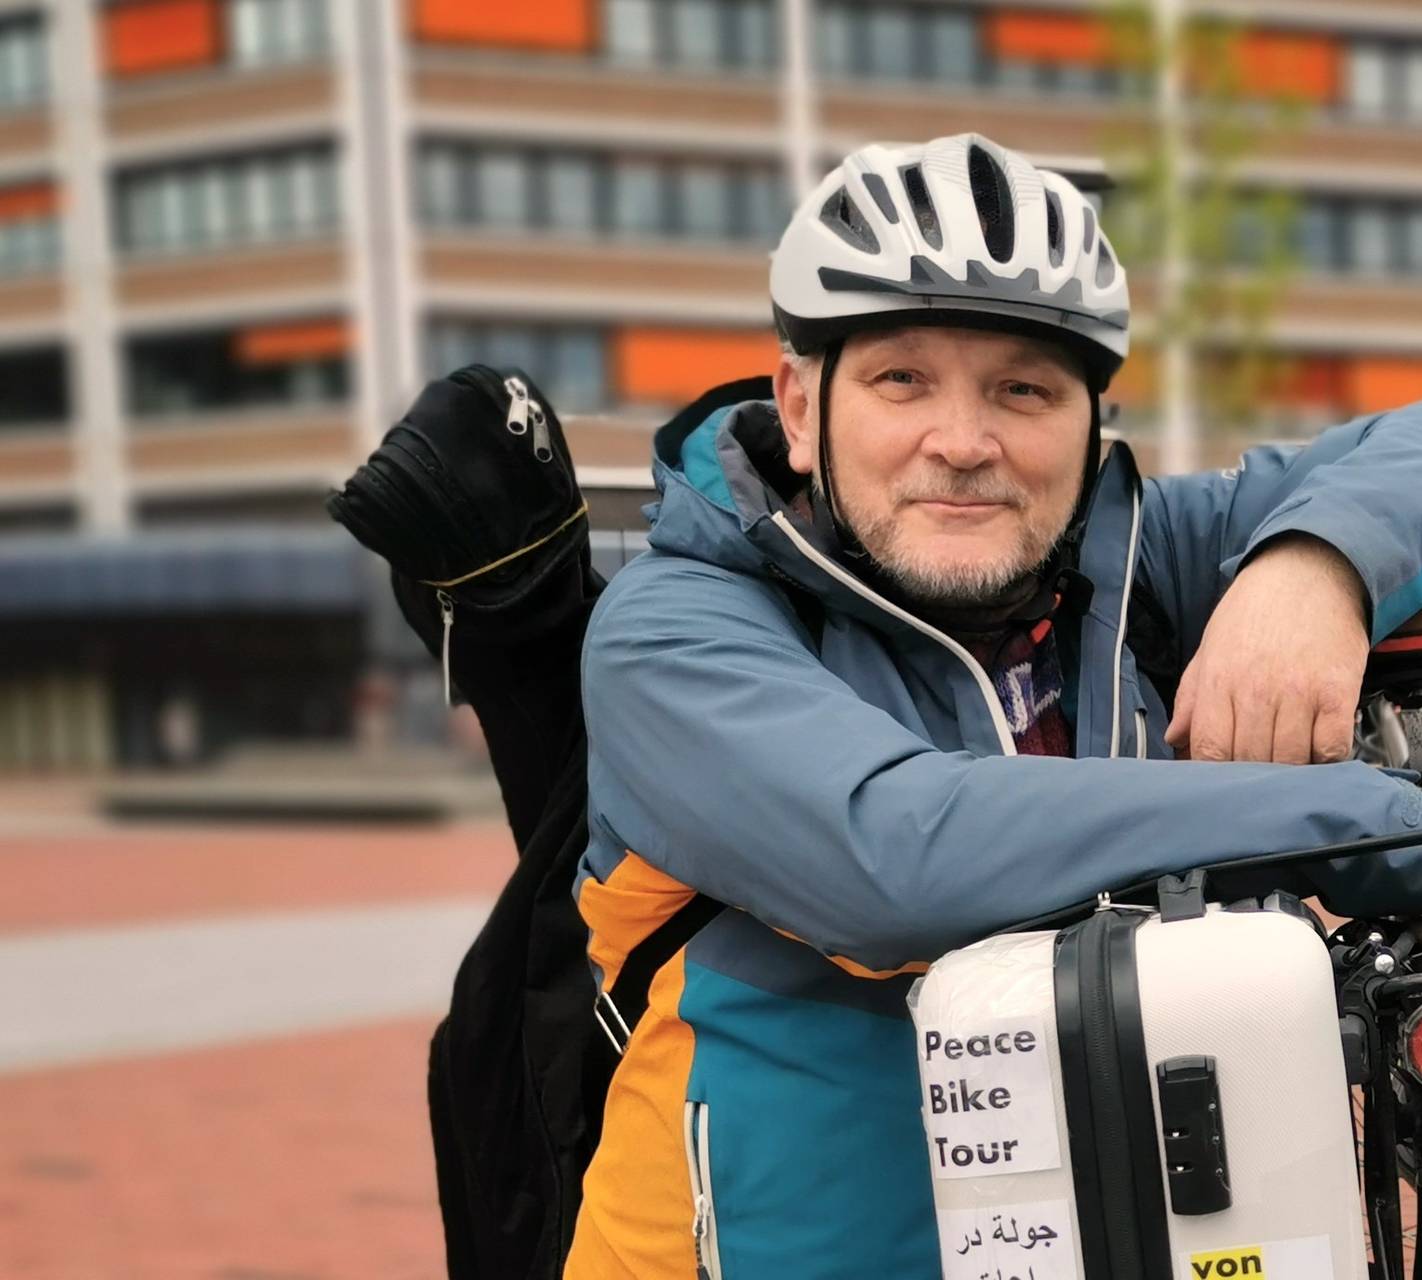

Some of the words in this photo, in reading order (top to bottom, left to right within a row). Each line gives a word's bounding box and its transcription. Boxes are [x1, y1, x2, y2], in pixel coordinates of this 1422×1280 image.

[925, 1028, 1036, 1061] Peace
[930, 1079, 1012, 1114] Bike
[934, 1137, 1018, 1167] Tour
[956, 1227, 982, 1255] در
[992, 1214, 1058, 1250] جولة
[1191, 1254, 1262, 1280] von
